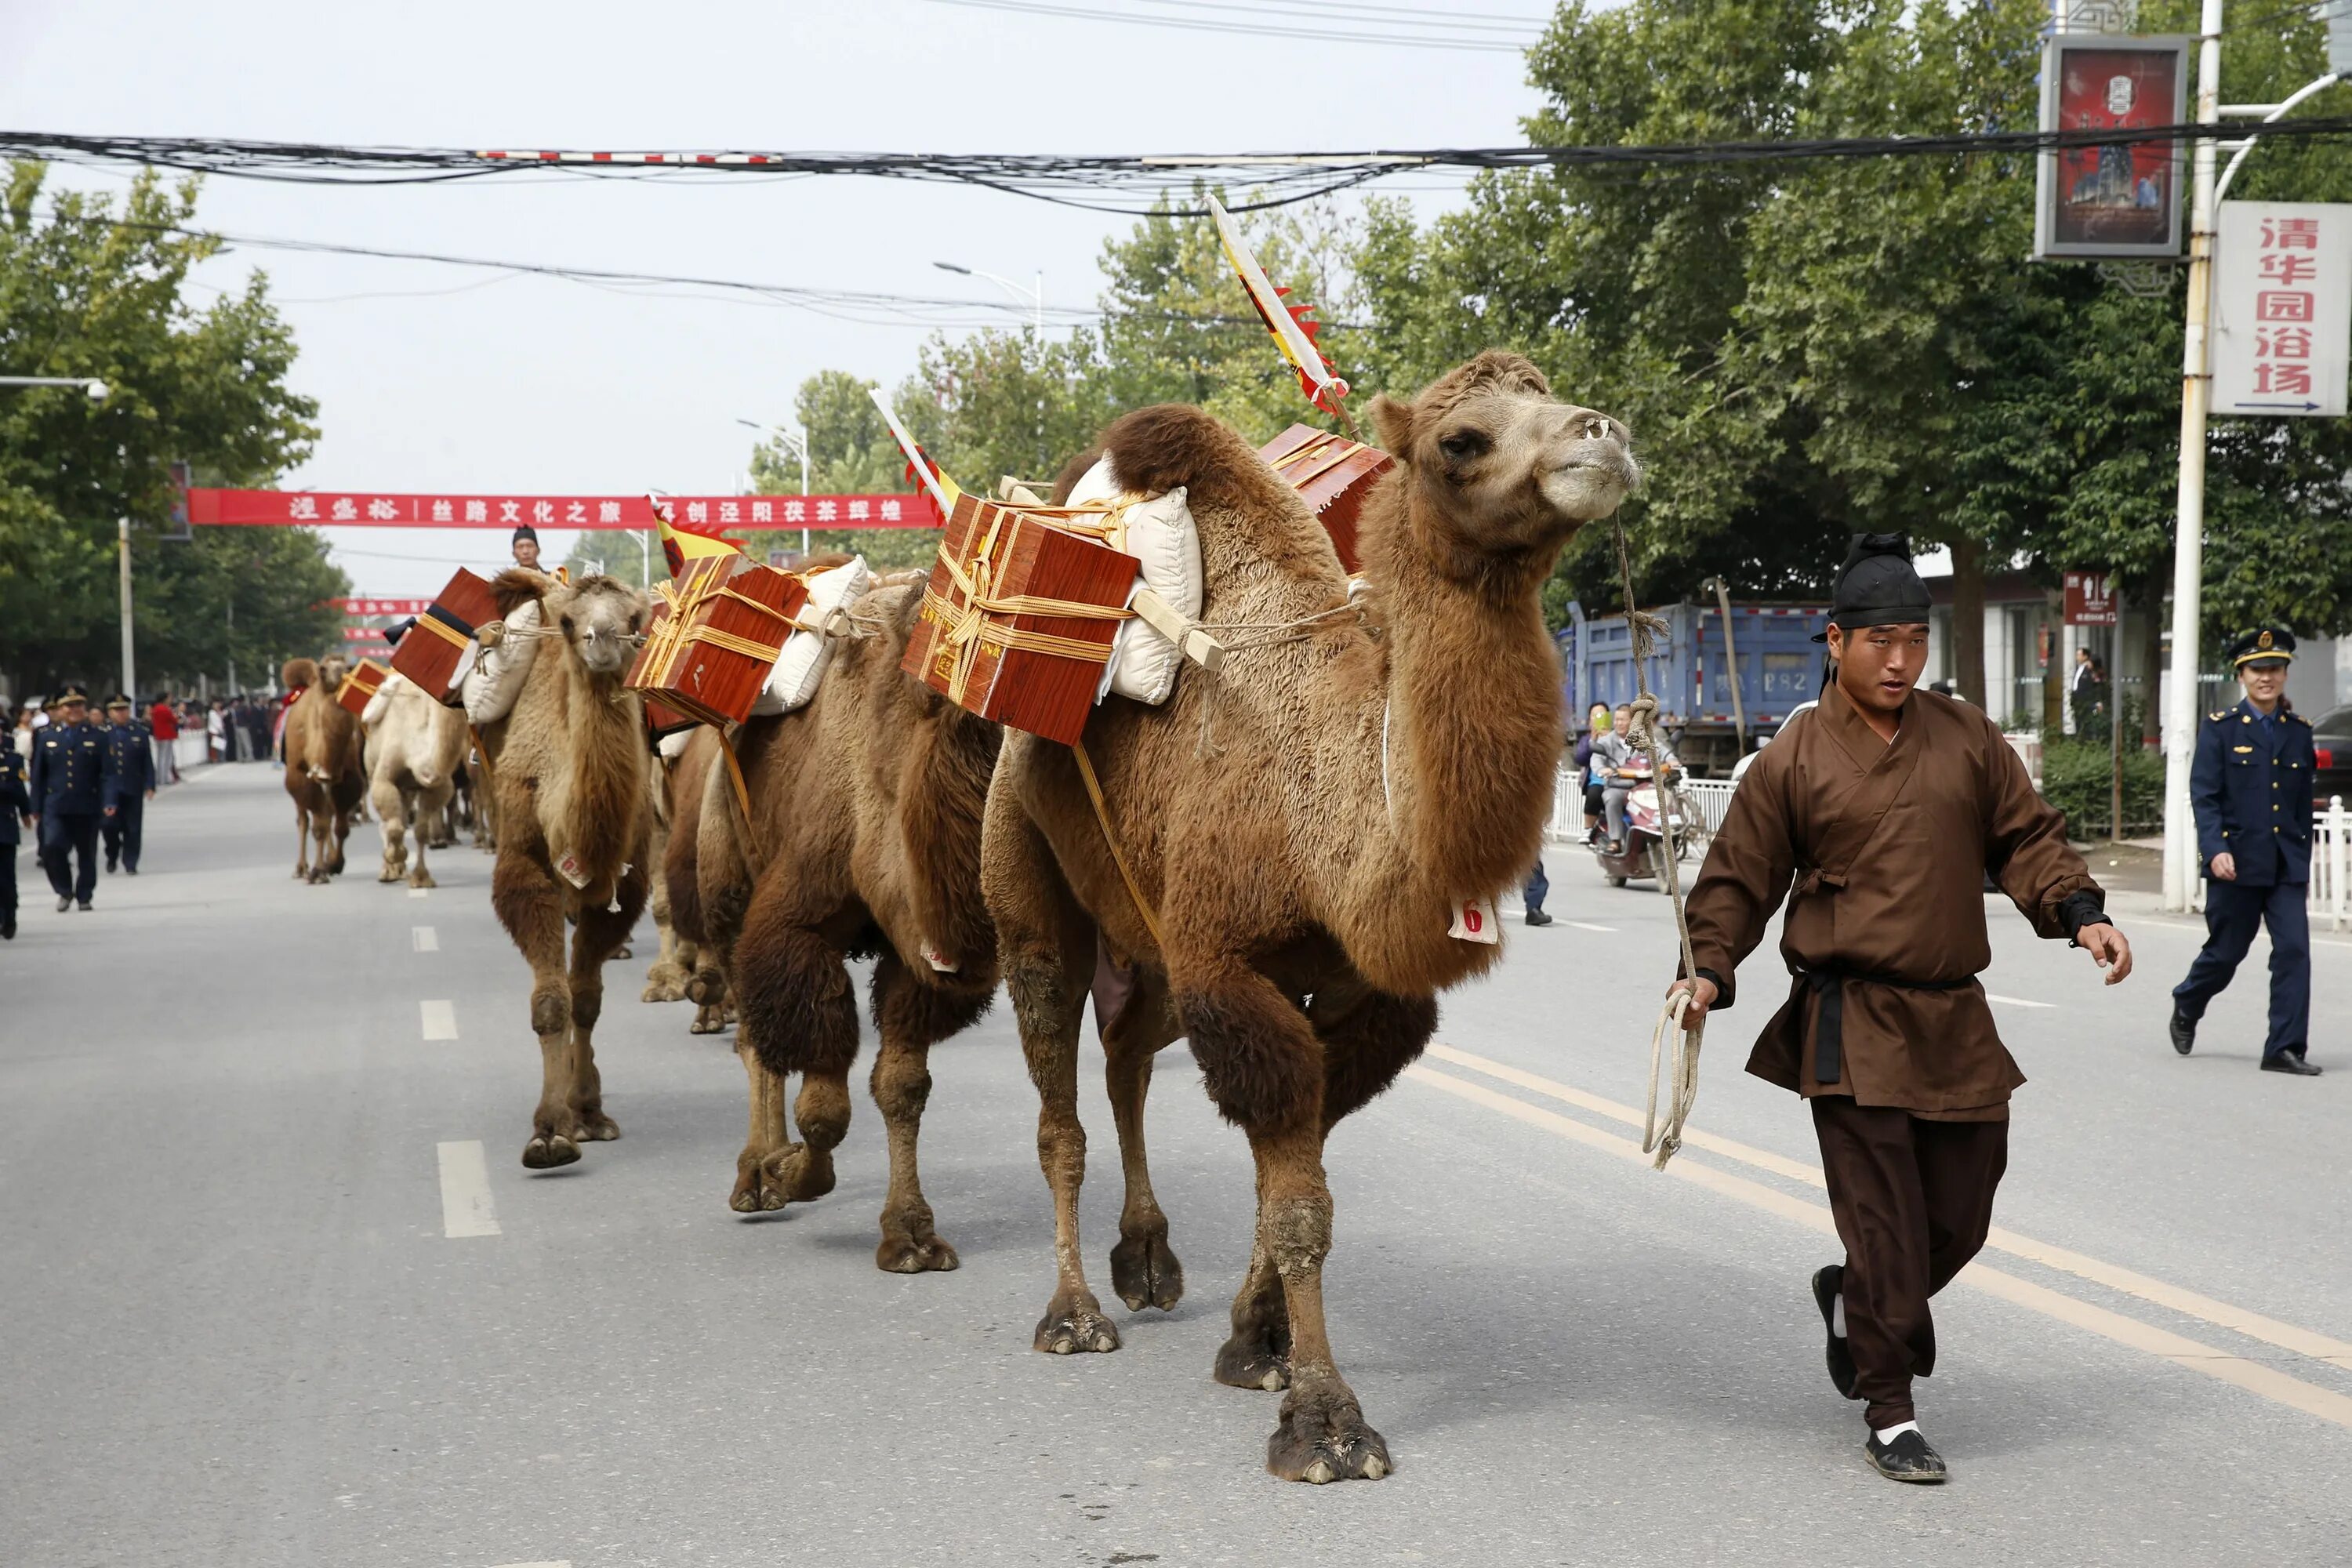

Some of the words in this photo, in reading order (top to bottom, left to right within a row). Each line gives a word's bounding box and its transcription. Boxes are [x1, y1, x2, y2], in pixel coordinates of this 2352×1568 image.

[2252, 217, 2318, 394] 清华园浴场
[432, 499, 621, 522] 丝路文化之旅
